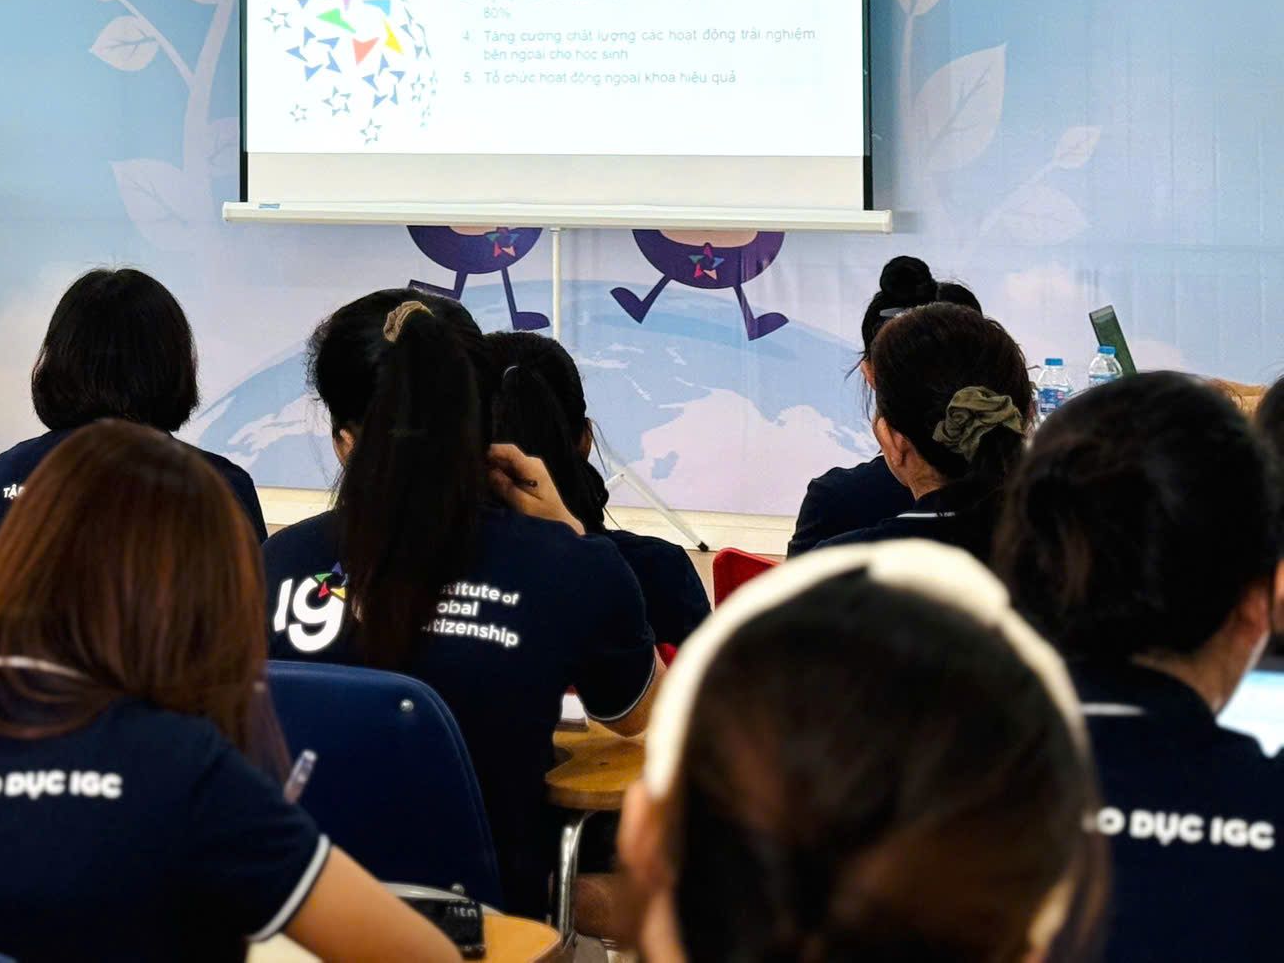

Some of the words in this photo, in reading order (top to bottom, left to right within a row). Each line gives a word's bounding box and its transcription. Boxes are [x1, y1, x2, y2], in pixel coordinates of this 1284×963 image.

[502, 593, 520, 606] of
[4, 770, 67, 801] DỤC
[69, 770, 123, 800] IGC
[1129, 808, 1205, 847] DỤC
[1209, 816, 1276, 851] IGC
